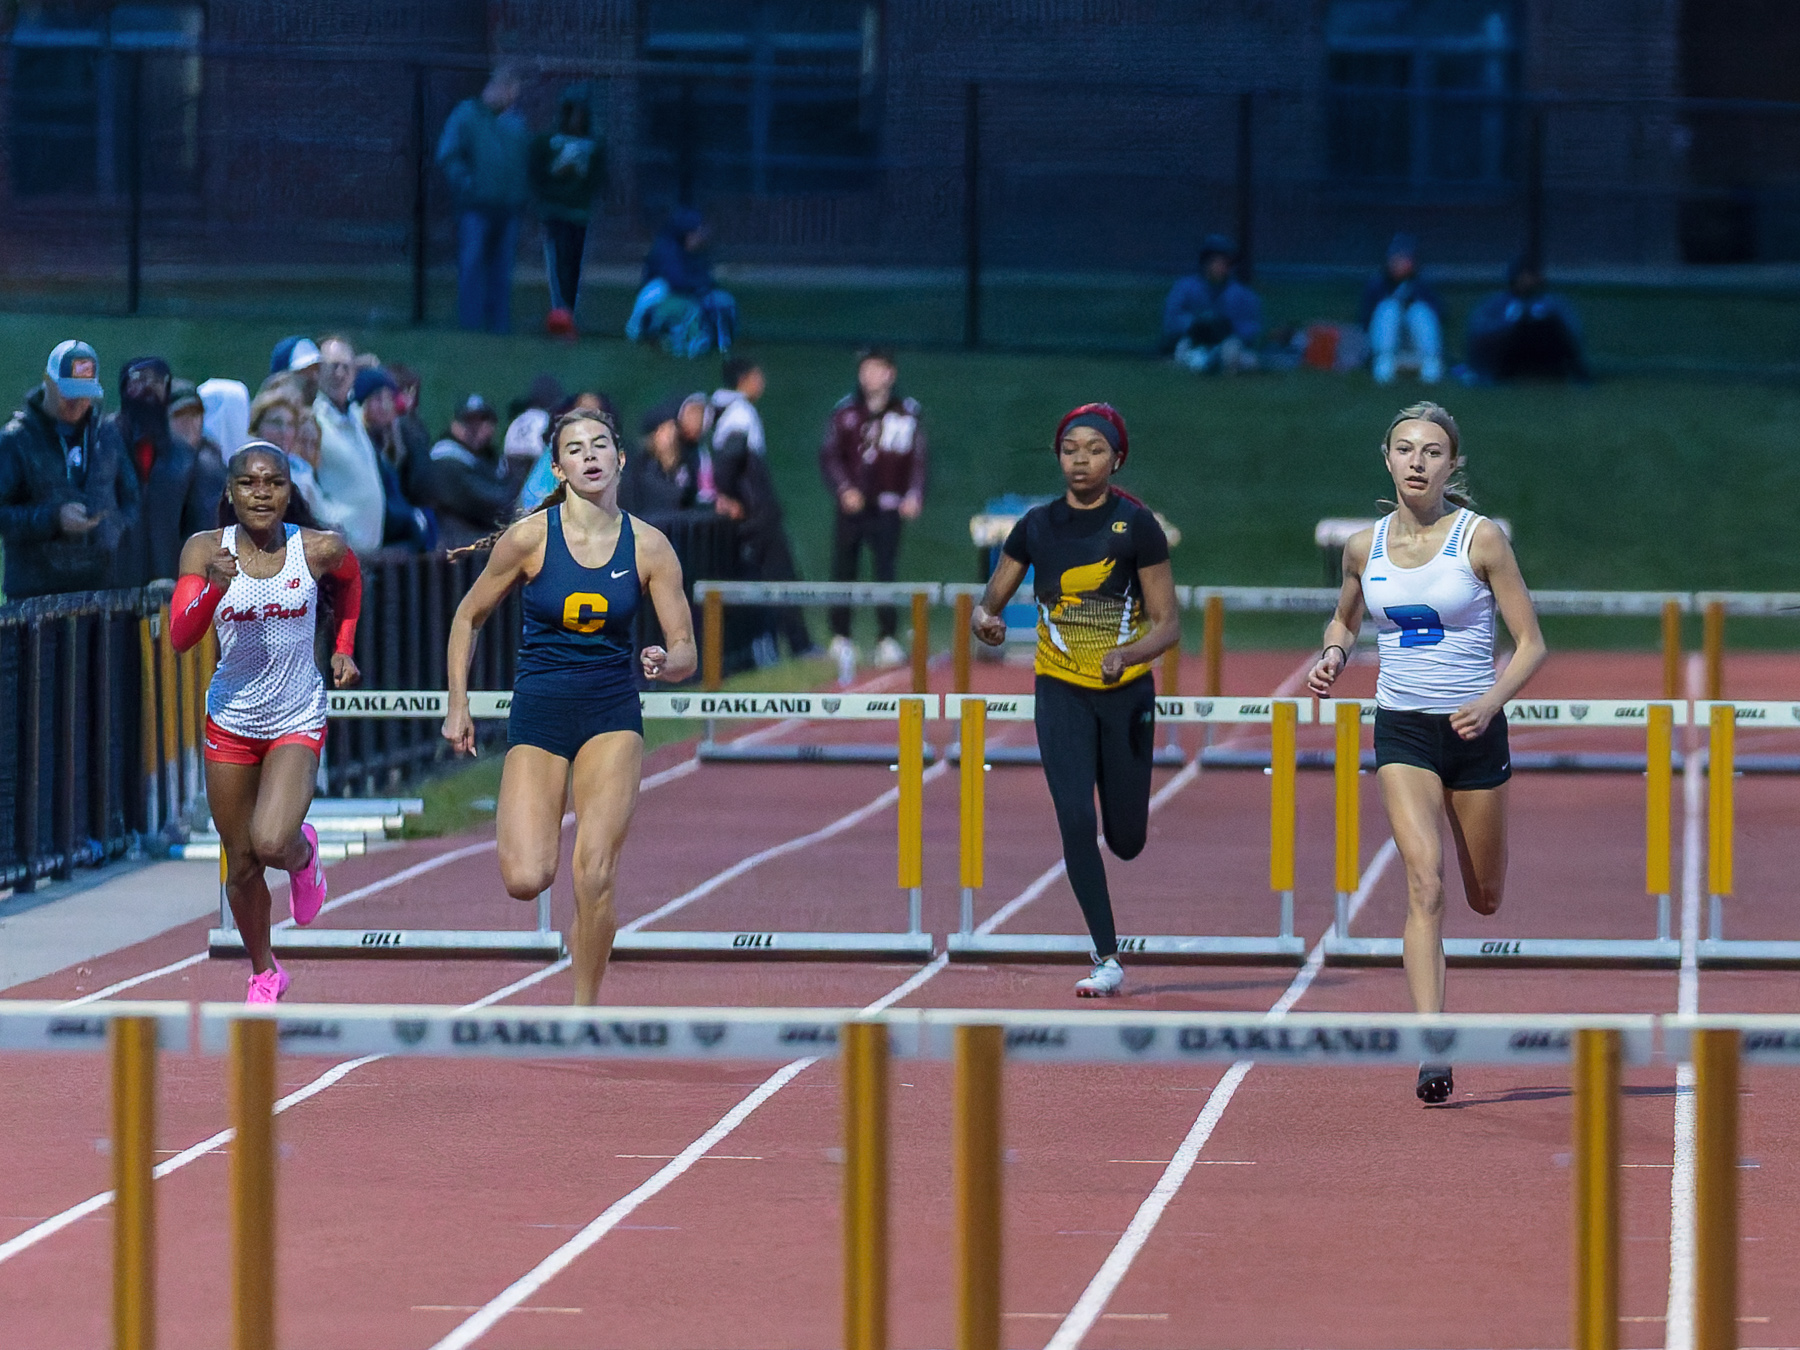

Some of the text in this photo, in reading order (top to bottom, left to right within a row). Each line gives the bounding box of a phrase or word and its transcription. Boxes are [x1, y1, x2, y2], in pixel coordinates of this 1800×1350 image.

[221, 601, 308, 622] Oak Park
[563, 592, 608, 633] C
[1383, 604, 1445, 647] B
[331, 697, 440, 711] OAKLAND
[701, 698, 811, 713] OAKLAND
[866, 701, 897, 711] GILL
[1239, 704, 1270, 715] GILL
[361, 933, 401, 945] GILL
[733, 934, 773, 947] GILL
[1117, 938, 1146, 950] ILL
[1481, 941, 1520, 954] GILL
[451, 1019, 670, 1047] OAKLAND
[1178, 1026, 1399, 1053] OAKLAND
